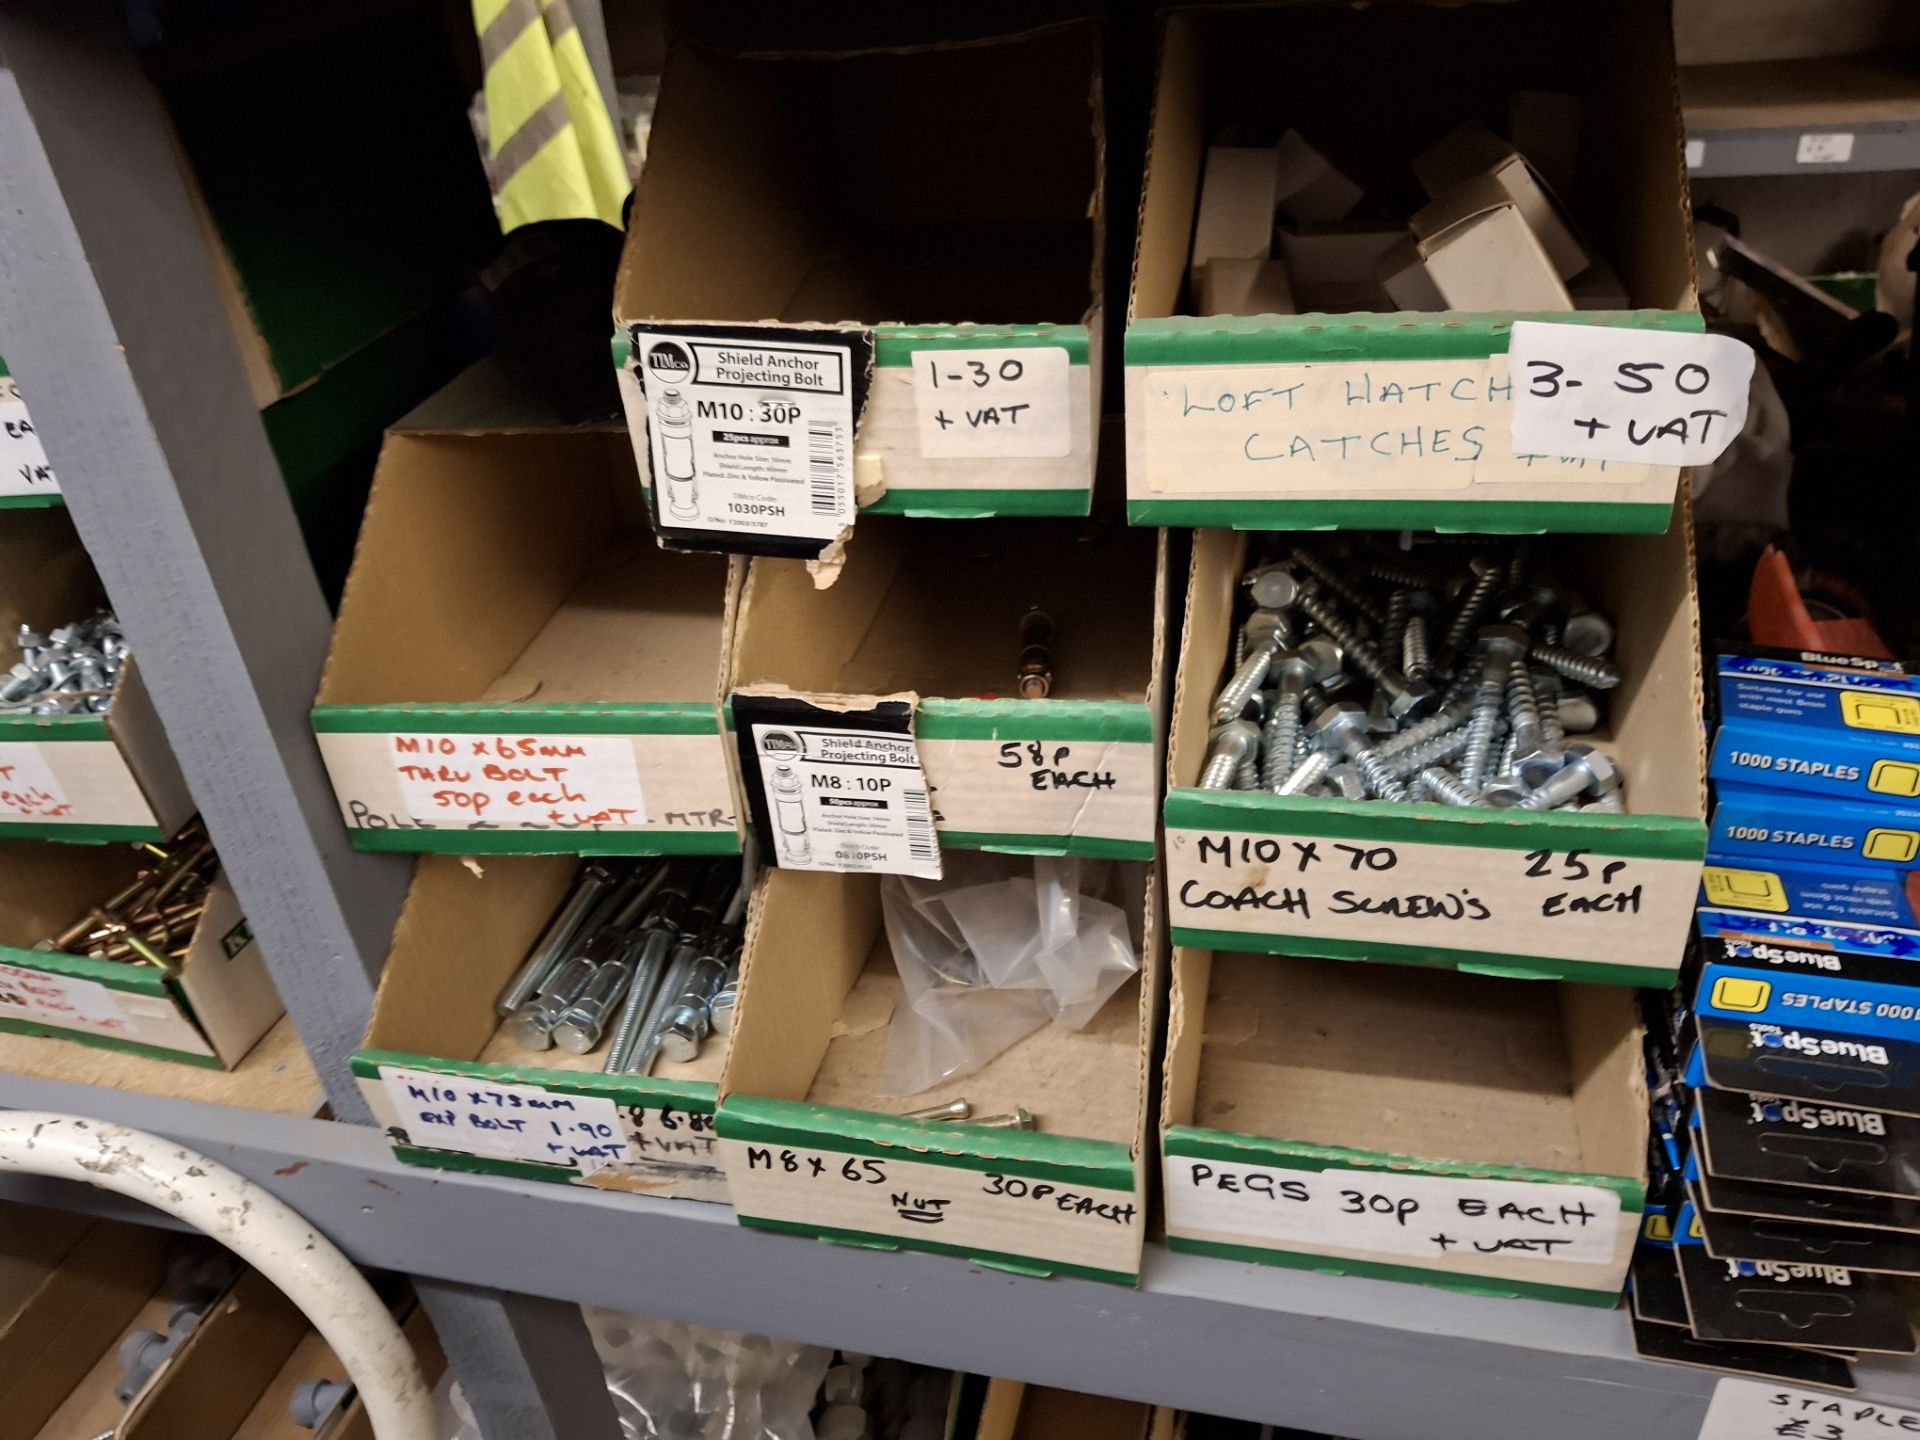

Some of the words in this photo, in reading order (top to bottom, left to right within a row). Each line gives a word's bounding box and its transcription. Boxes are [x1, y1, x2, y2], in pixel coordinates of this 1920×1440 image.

[718, 352, 763, 366] Shield
[764, 356, 819, 370] Anchor
[717, 368, 791, 385] Projecting
[795, 373, 823, 386] Bolt
[931, 358, 1024, 389] 1-30
[1181, 382, 1304, 416] LOFT
[1345, 374, 1512, 408] HATCH
[697, 400, 743, 420] M10
[760, 404, 801, 424] 30P
[936, 410, 954, 430] +
[966, 404, 1030, 427] VAT
[1574, 417, 1611, 438] +
[1628, 410, 1727, 445] VAT
[1245, 427, 1487, 462] CATCHES
[728, 503, 785, 516] 1030PSH
[396, 737, 455, 755] M10
[822, 739, 861, 748] Shield
[866, 741, 910, 752] Anchor
[821, 750, 886, 763] Projecting
[890, 754, 915, 764] Bolt
[1730, 751, 1772, 768] 1000
[1774, 758, 1860, 780] STAPLES
[398, 765, 471, 782] THRU
[483, 764, 568, 782] BOLT
[811, 774, 841, 789] M8
[857, 778, 891, 792] 10P
[1030, 770, 1115, 791] EACH
[507, 784, 586, 805] each
[548, 811, 563, 822] +
[574, 809, 636, 824] VAT
[1728, 826, 1769, 841] 1000
[1771, 831, 1855, 848] STAPLES
[1198, 836, 1280, 868] M10
[1334, 844, 1397, 871] 70
[1179, 880, 1310, 920] COACH
[1542, 885, 1642, 917] EACH
[1725, 943, 1842, 970] BlueSpot
[1782, 992, 1873, 1014] STAPLES
[1751, 1031, 1889, 1065] BlueSpot
[408, 1085, 457, 1103] M10
[469, 1113, 526, 1132] BOLT
[1750, 1101, 1886, 1136] BlueSpot
[572, 1144, 627, 1159] VAT
[892, 1192, 951, 1210] NUT
[1191, 1164, 1310, 1202] PEGS
[1458, 1198, 1595, 1225] EACH
[1056, 1194, 1137, 1224] EACH
[1430, 1233, 1457, 1251] +
[1474, 1238, 1572, 1255] VAT
